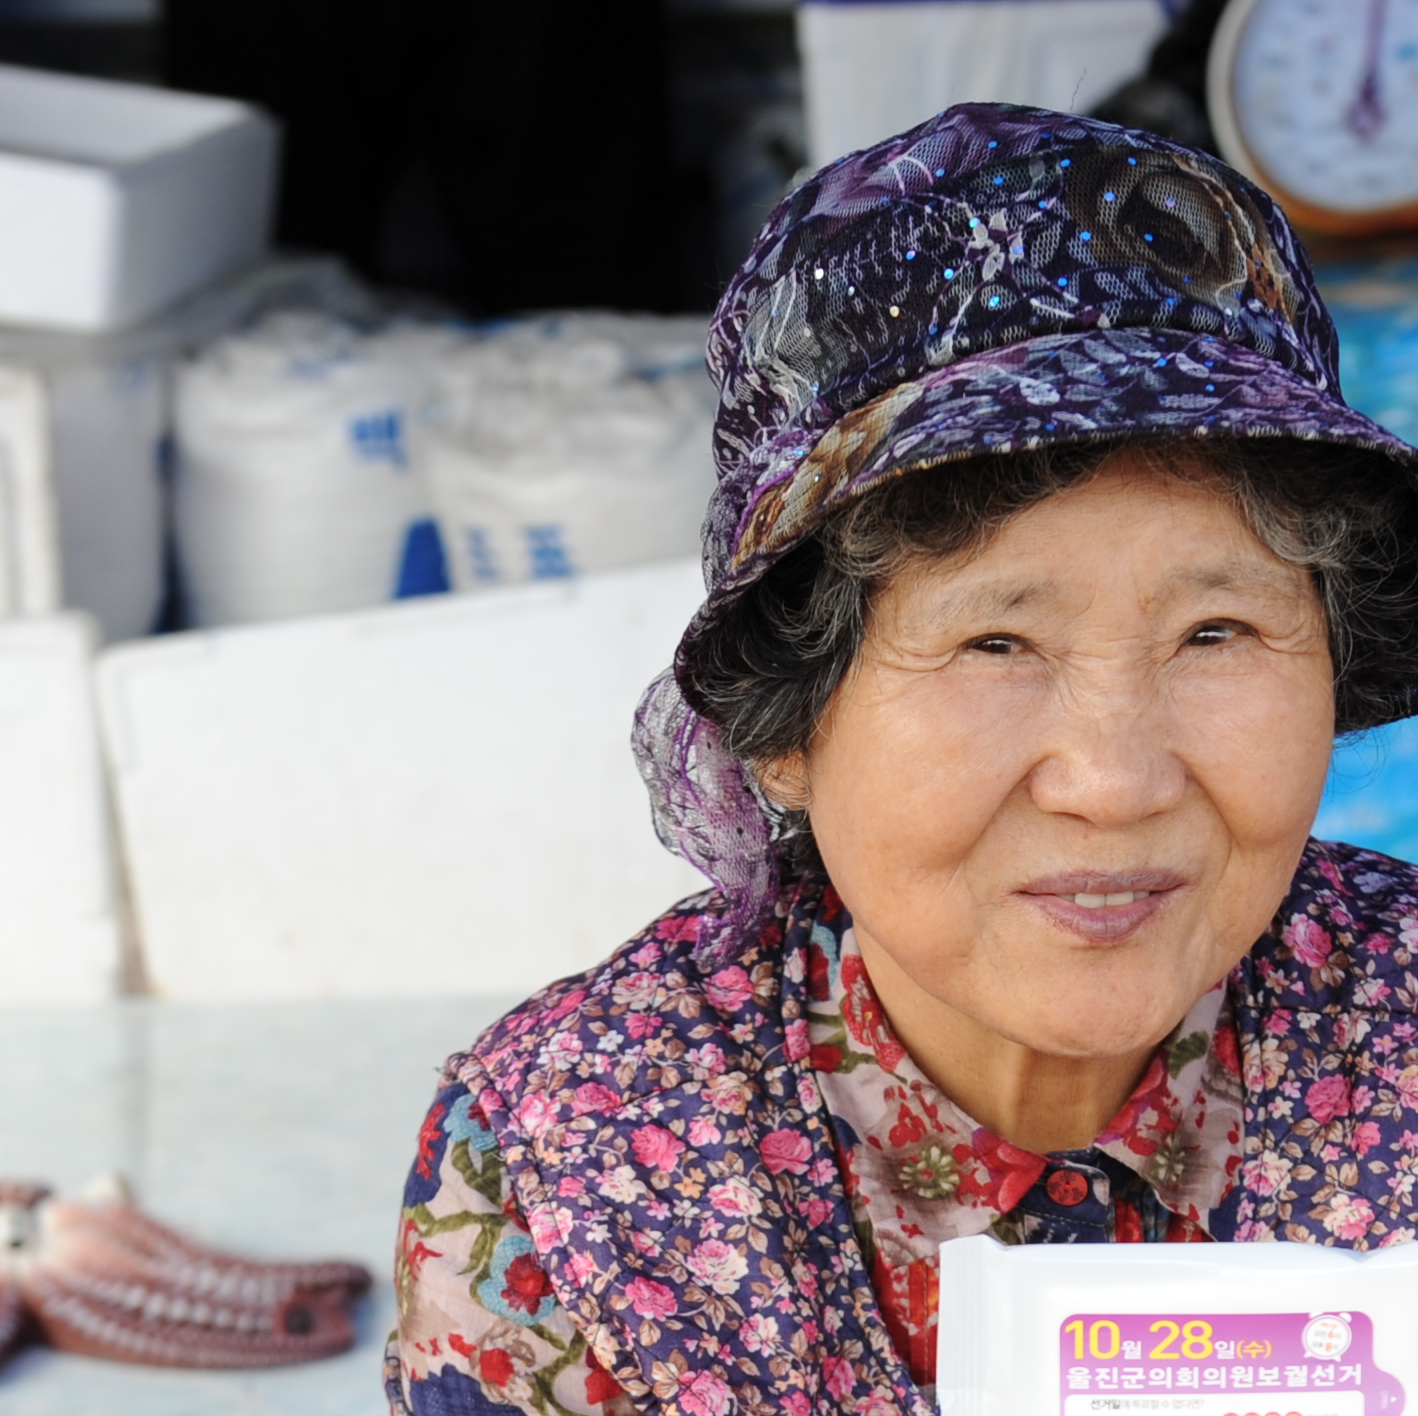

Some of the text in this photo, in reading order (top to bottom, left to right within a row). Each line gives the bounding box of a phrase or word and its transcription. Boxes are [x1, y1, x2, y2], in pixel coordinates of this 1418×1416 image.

[1065, 1319, 1272, 1360] 10월 28일(수)
[1066, 1363, 1362, 1390] 울진군의회의원보궐선거
